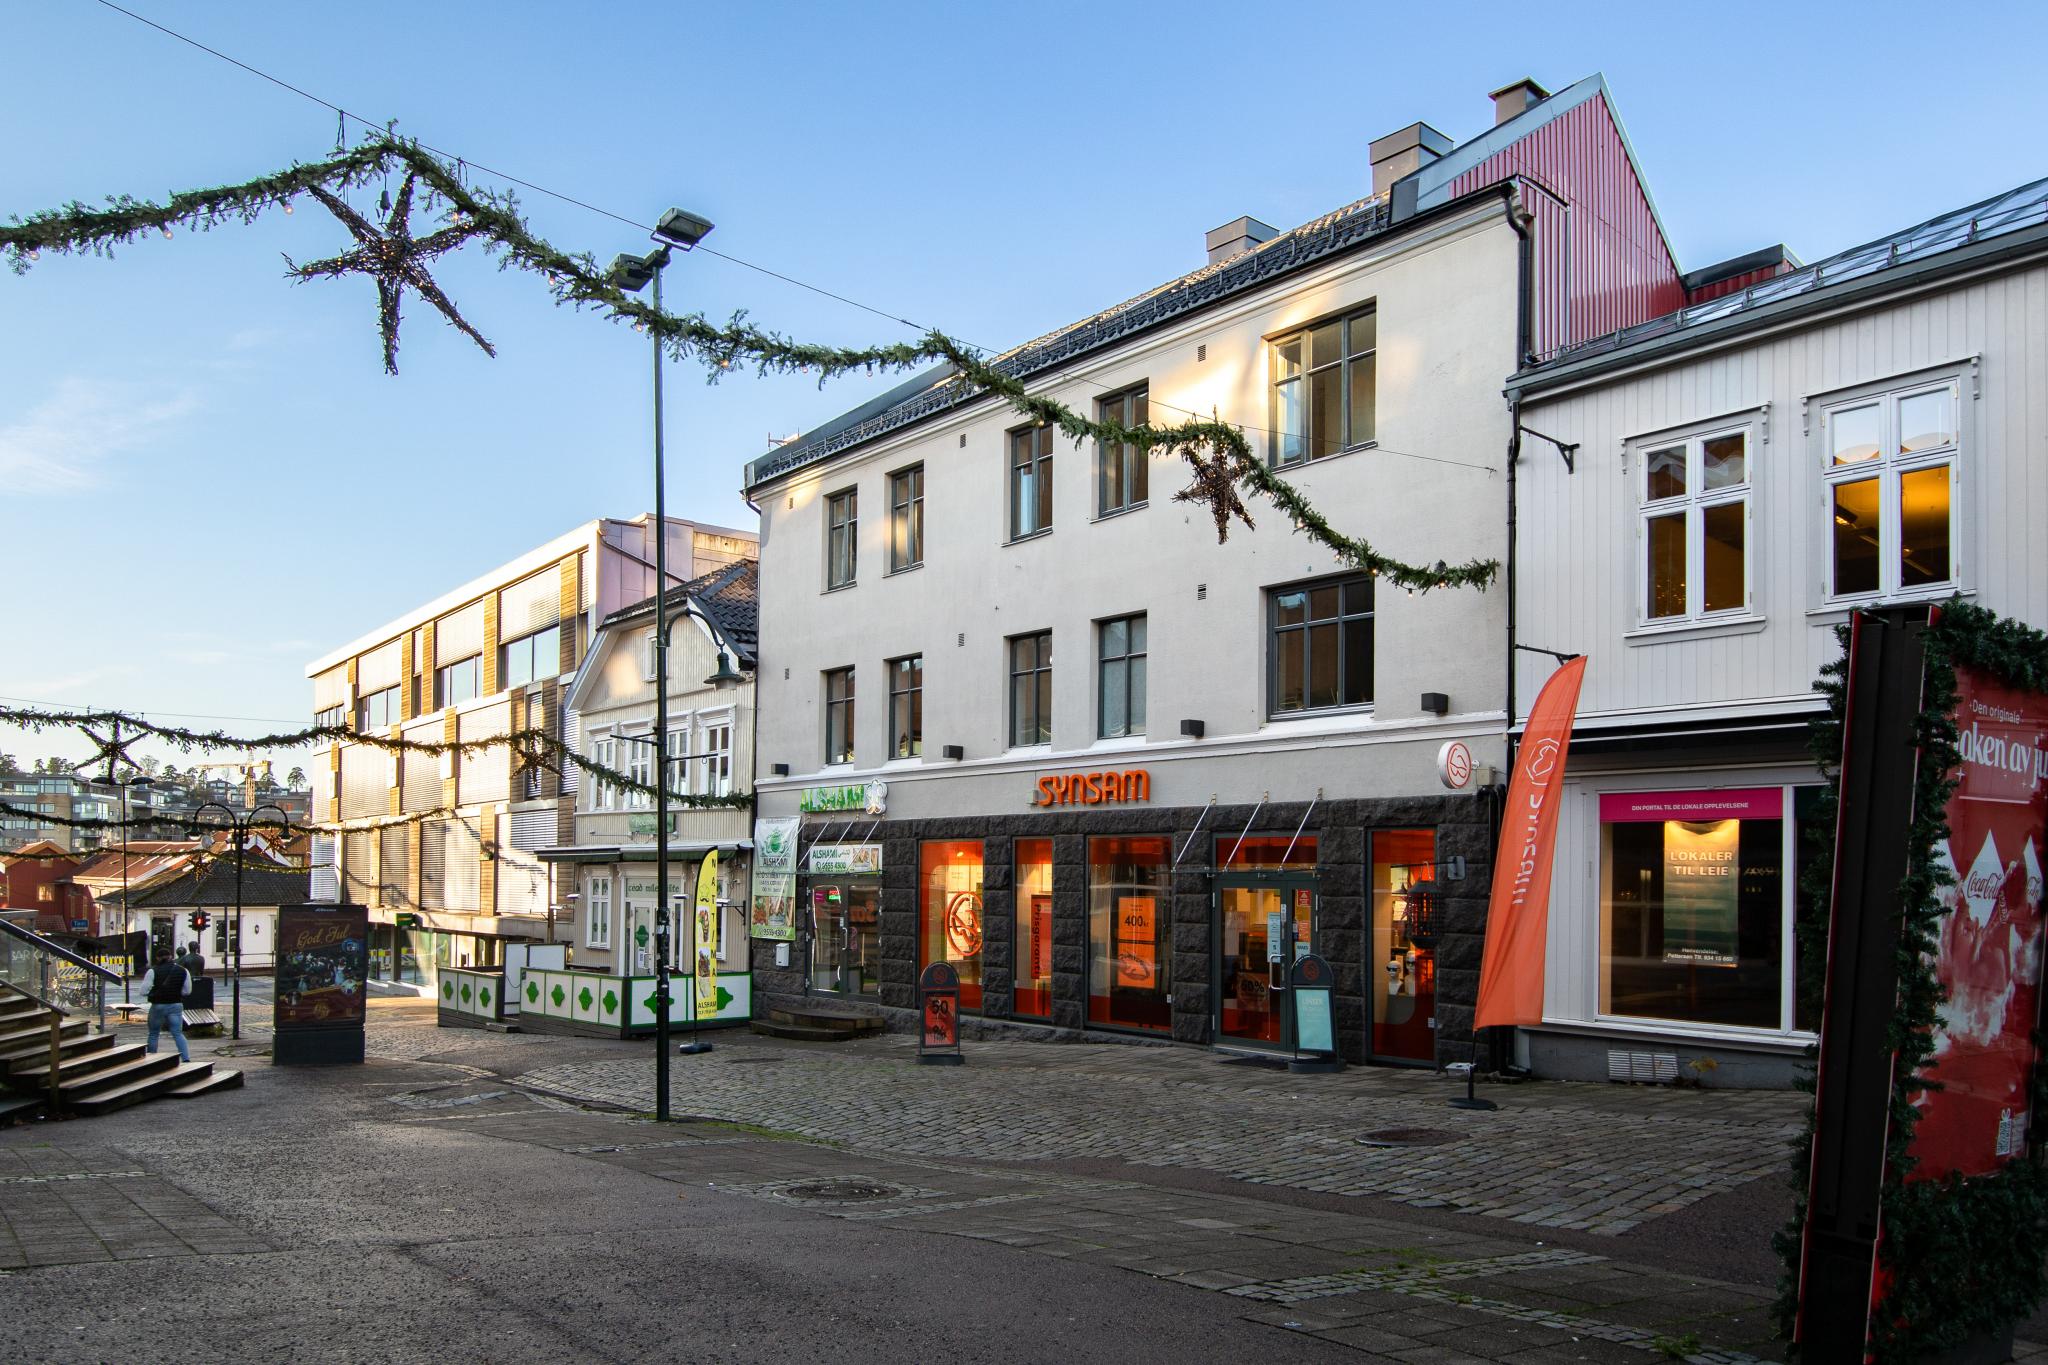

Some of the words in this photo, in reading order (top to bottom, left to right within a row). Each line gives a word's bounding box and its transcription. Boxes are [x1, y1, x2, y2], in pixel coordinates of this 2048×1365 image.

[1972, 700, 1988, 716] Den
[1989, 705, 2021, 724] originale
[1953, 722, 2007, 770] aken
[2009, 742, 2031, 774] av
[1039, 769, 1150, 806] SYNSAM
[1670, 851, 1733, 861] LOKALER
[1674, 865, 1695, 875] TIL
[1700, 866, 1729, 876] LEIE
[1125, 915, 1143, 927] 400
